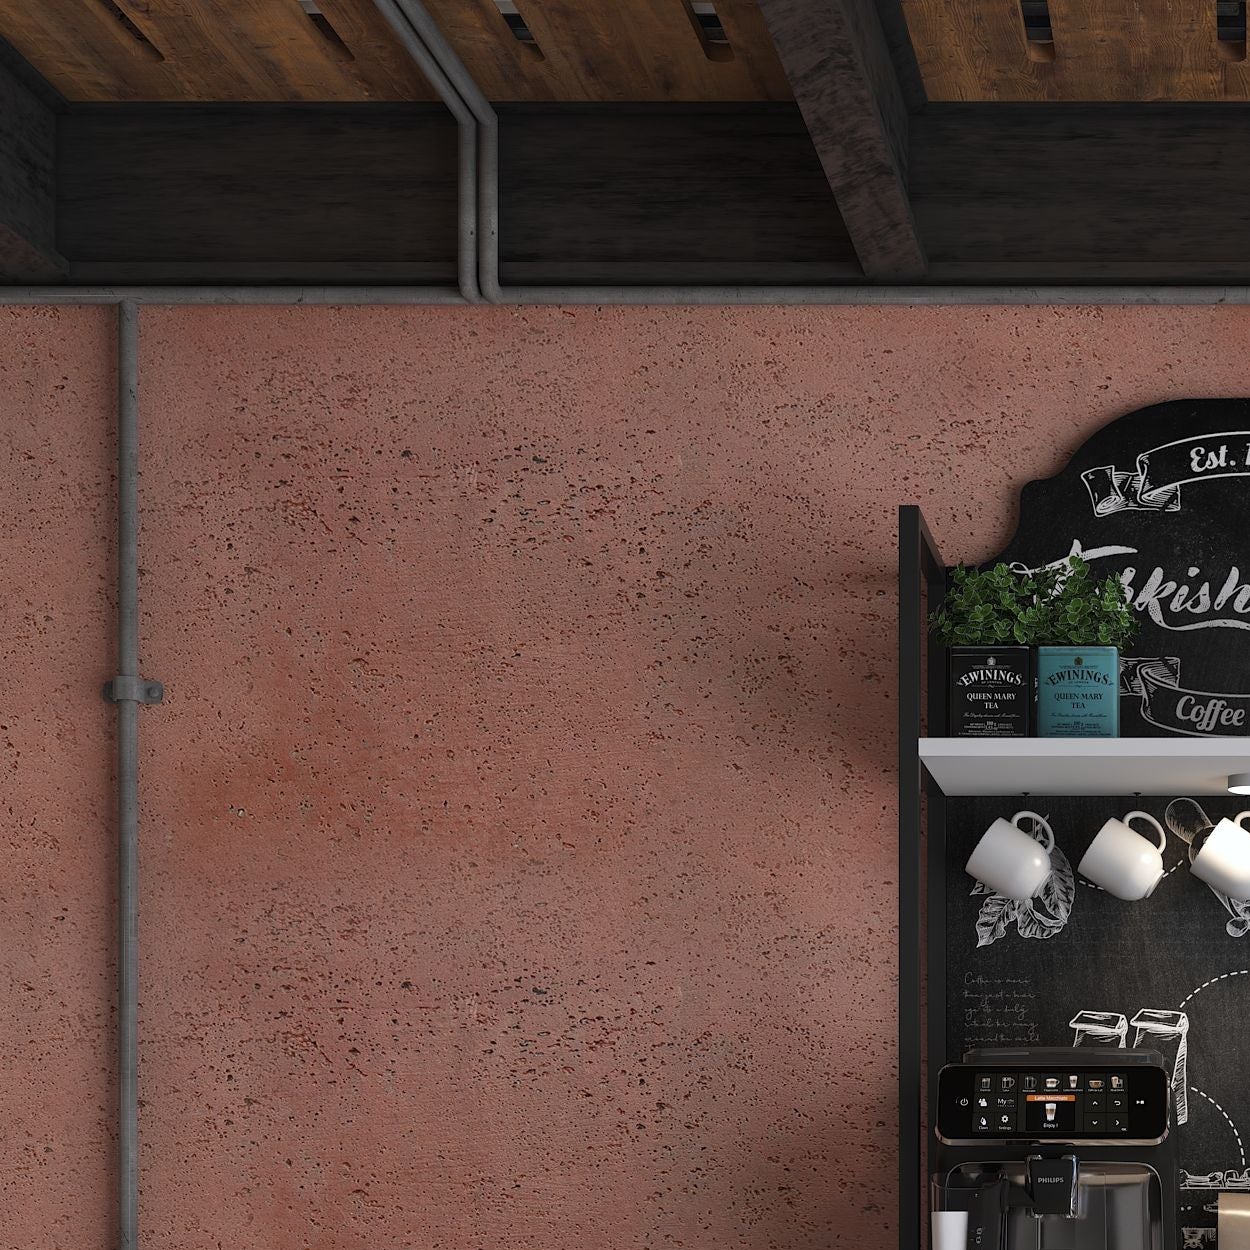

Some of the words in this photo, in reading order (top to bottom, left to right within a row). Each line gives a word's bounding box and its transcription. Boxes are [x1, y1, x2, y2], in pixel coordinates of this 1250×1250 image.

[1190, 446, 1236, 473] Est.
[960, 669, 1022, 687] EWININGS
[966, 693, 992, 702] QUEEN
[993, 693, 1016, 701] MARY
[1054, 693, 1080, 702] QUEEN
[1081, 693, 1104, 701] MARY
[1176, 695, 1245, 731] Coffee
